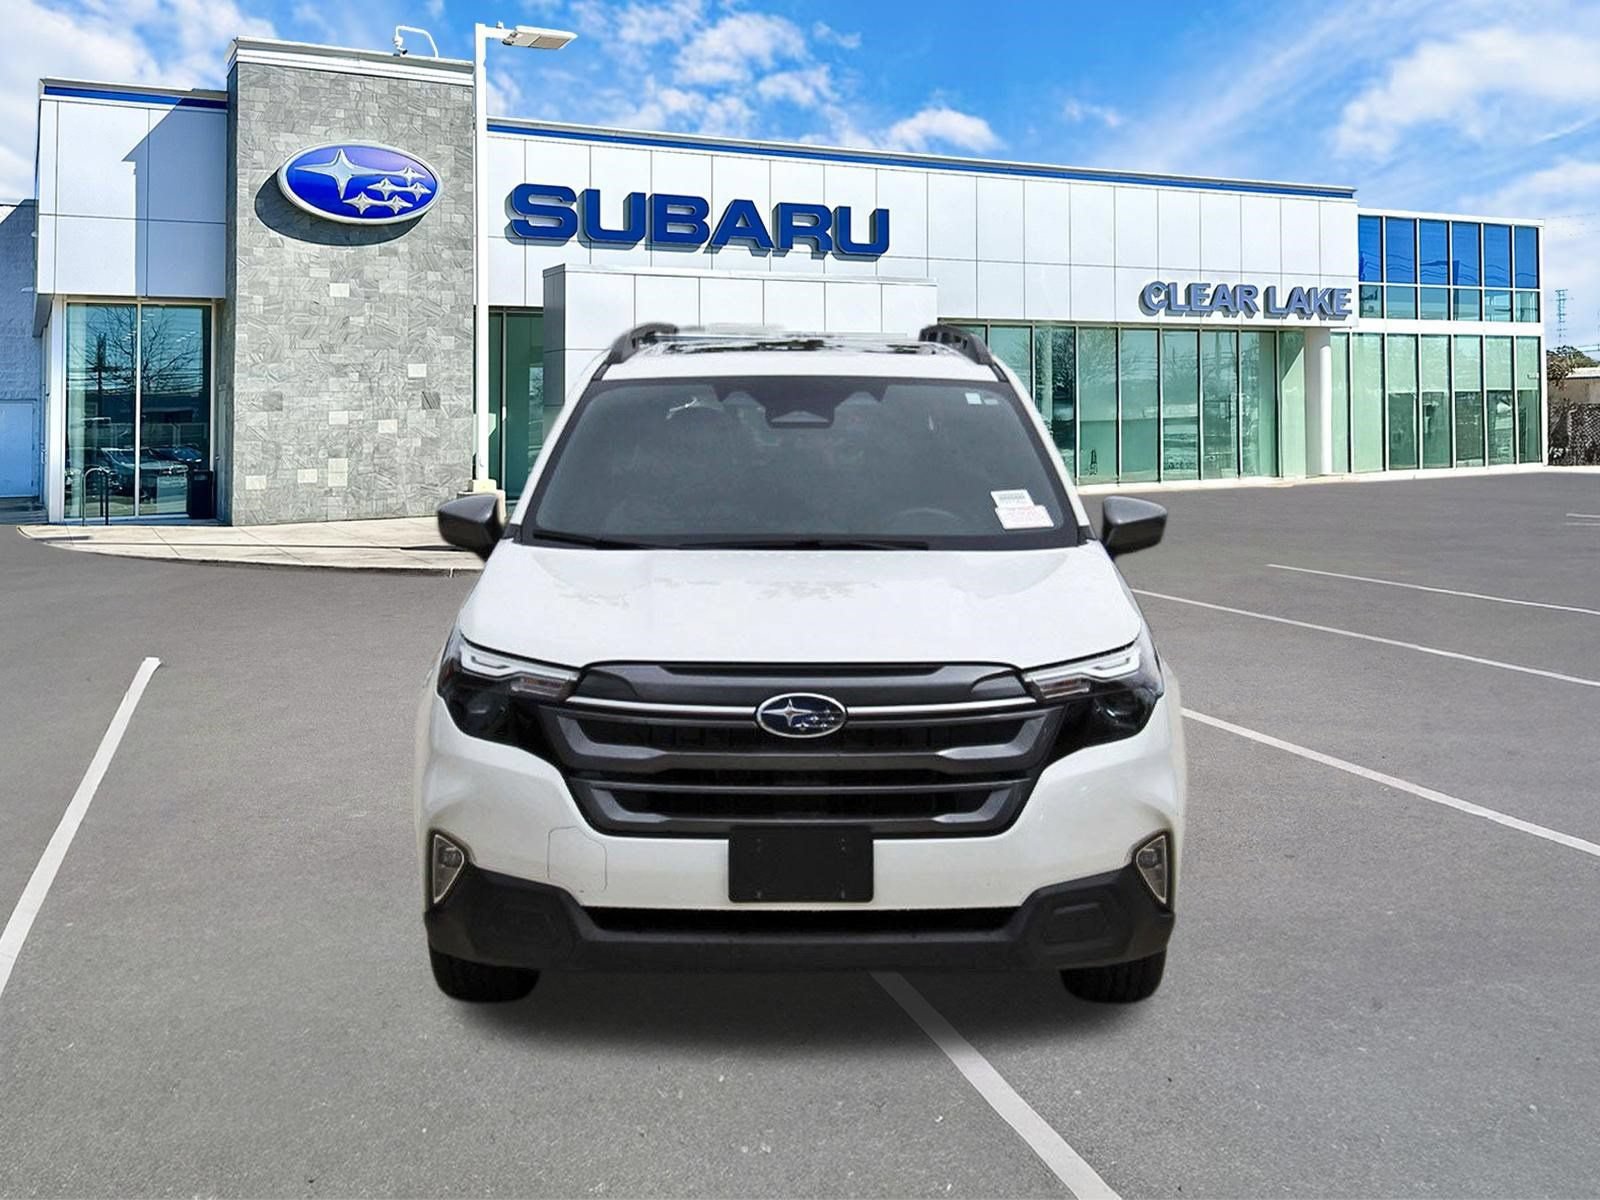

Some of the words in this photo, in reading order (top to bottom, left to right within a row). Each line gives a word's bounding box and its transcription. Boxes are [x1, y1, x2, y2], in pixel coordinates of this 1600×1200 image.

[506, 183, 890, 259] SUBARU
[1141, 281, 1260, 316] CLEAR
[1265, 286, 1352, 319] LAKE
